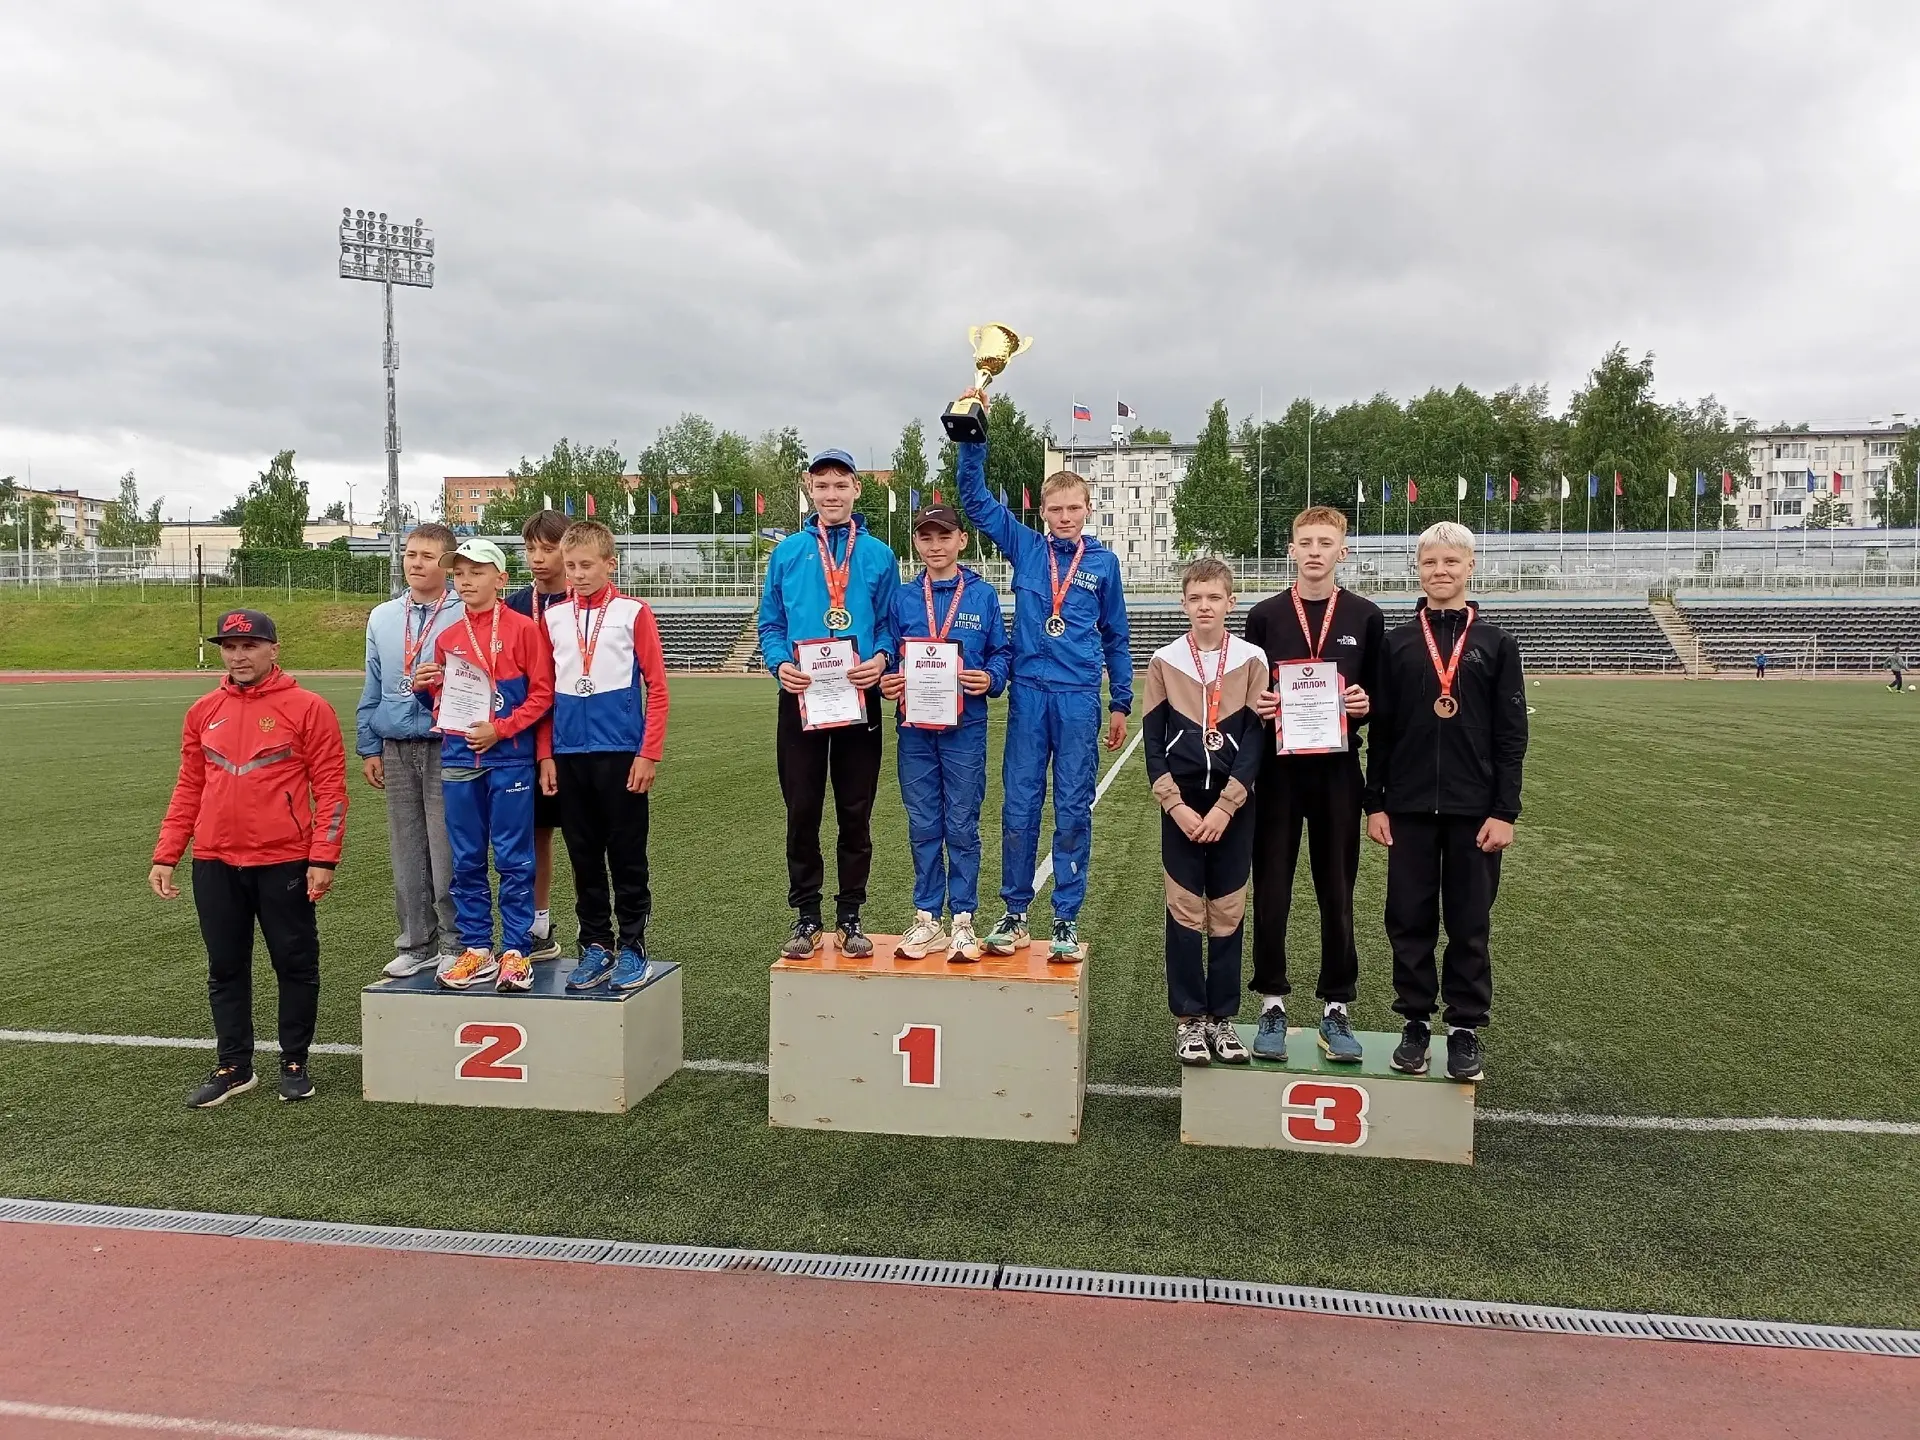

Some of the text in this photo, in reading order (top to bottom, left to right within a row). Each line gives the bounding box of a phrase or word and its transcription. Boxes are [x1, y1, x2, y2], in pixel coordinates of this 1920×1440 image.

[958, 612, 981, 623] ЛЕГКАЯ
[237, 623, 253, 632] SB
[812, 659, 844, 670] ДИПЛОМ
[915, 660, 947, 669] ДИПЛОМ
[455, 668, 482, 682] ДИПЛОМ
[1292, 680, 1326, 690] ДИПЛОМ
[456, 1022, 526, 1082] 2
[894, 1024, 940, 1087] 1
[1283, 1082, 1368, 1147] 3
